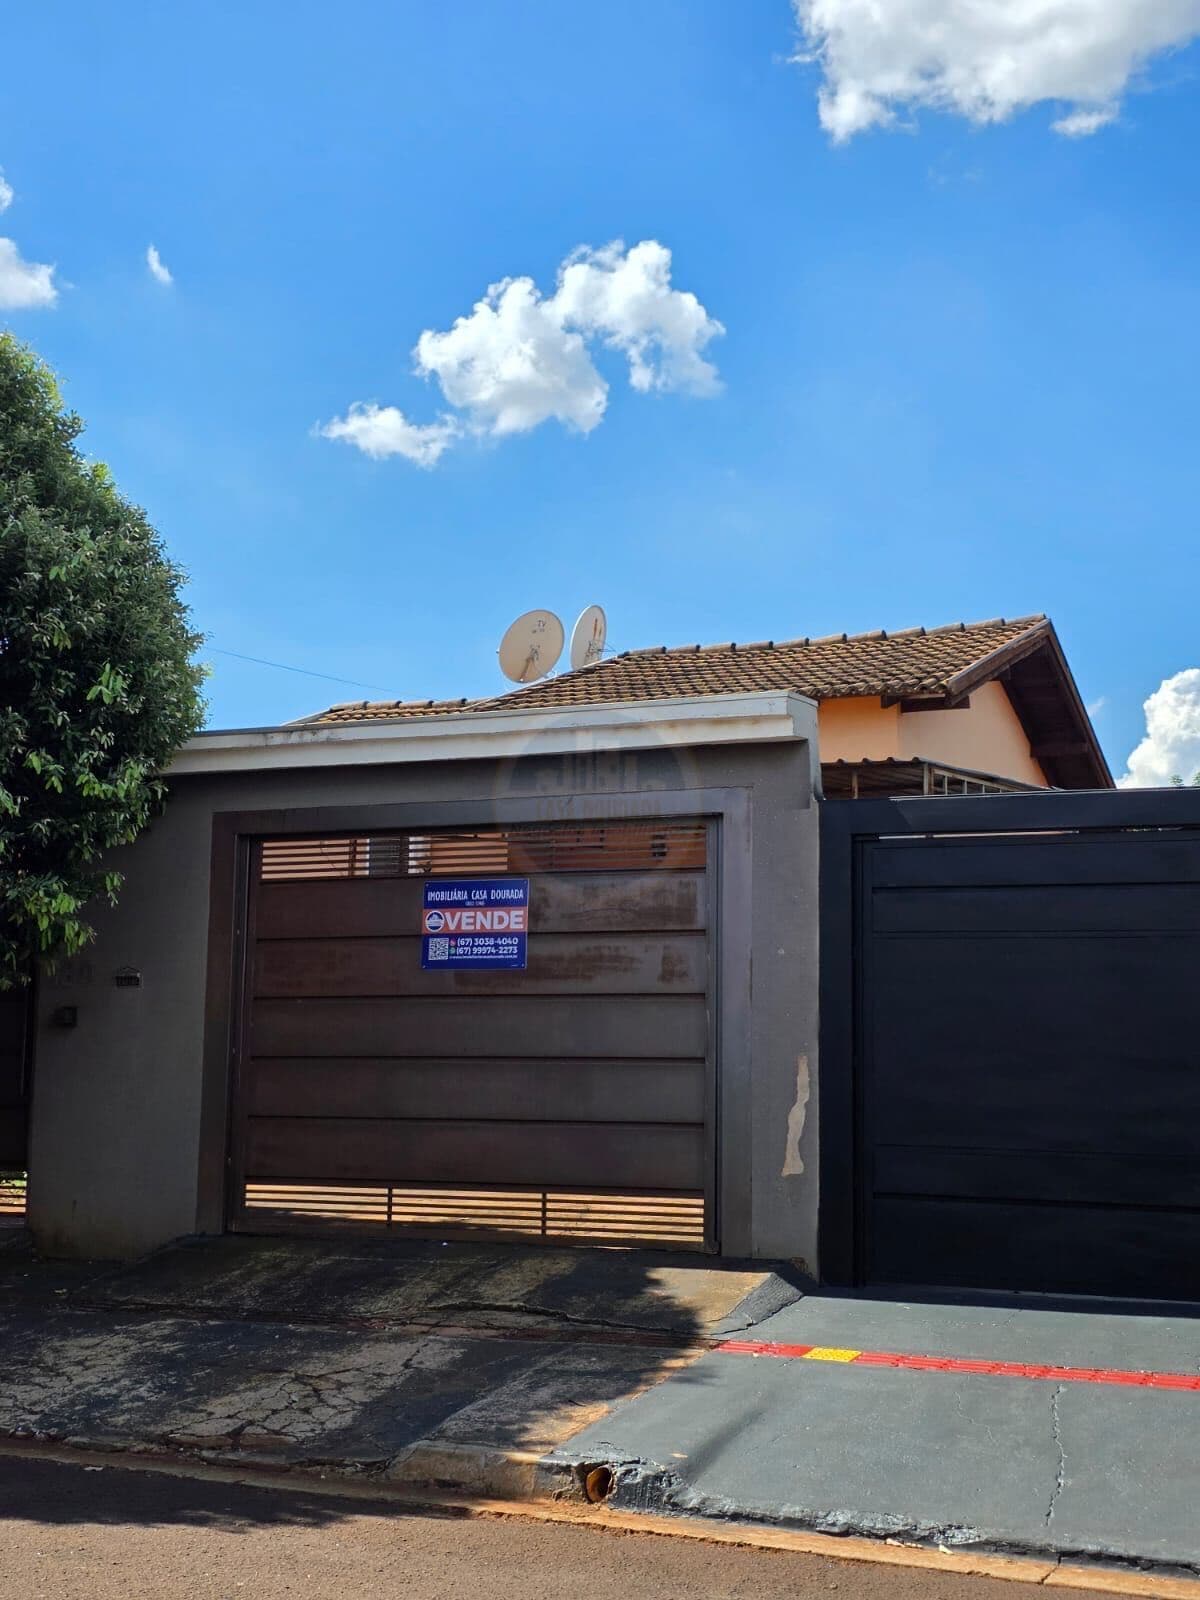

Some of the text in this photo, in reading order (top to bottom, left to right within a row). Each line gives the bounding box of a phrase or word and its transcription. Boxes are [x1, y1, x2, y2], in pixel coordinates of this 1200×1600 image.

[428, 889, 524, 901] IMOBILIÁRIA CASA DOURADA
[445, 911, 524, 930] VENDE
[457, 937, 518, 946] (67) 3038-4040
[456, 946, 518, 955] (67) 99974-2273
